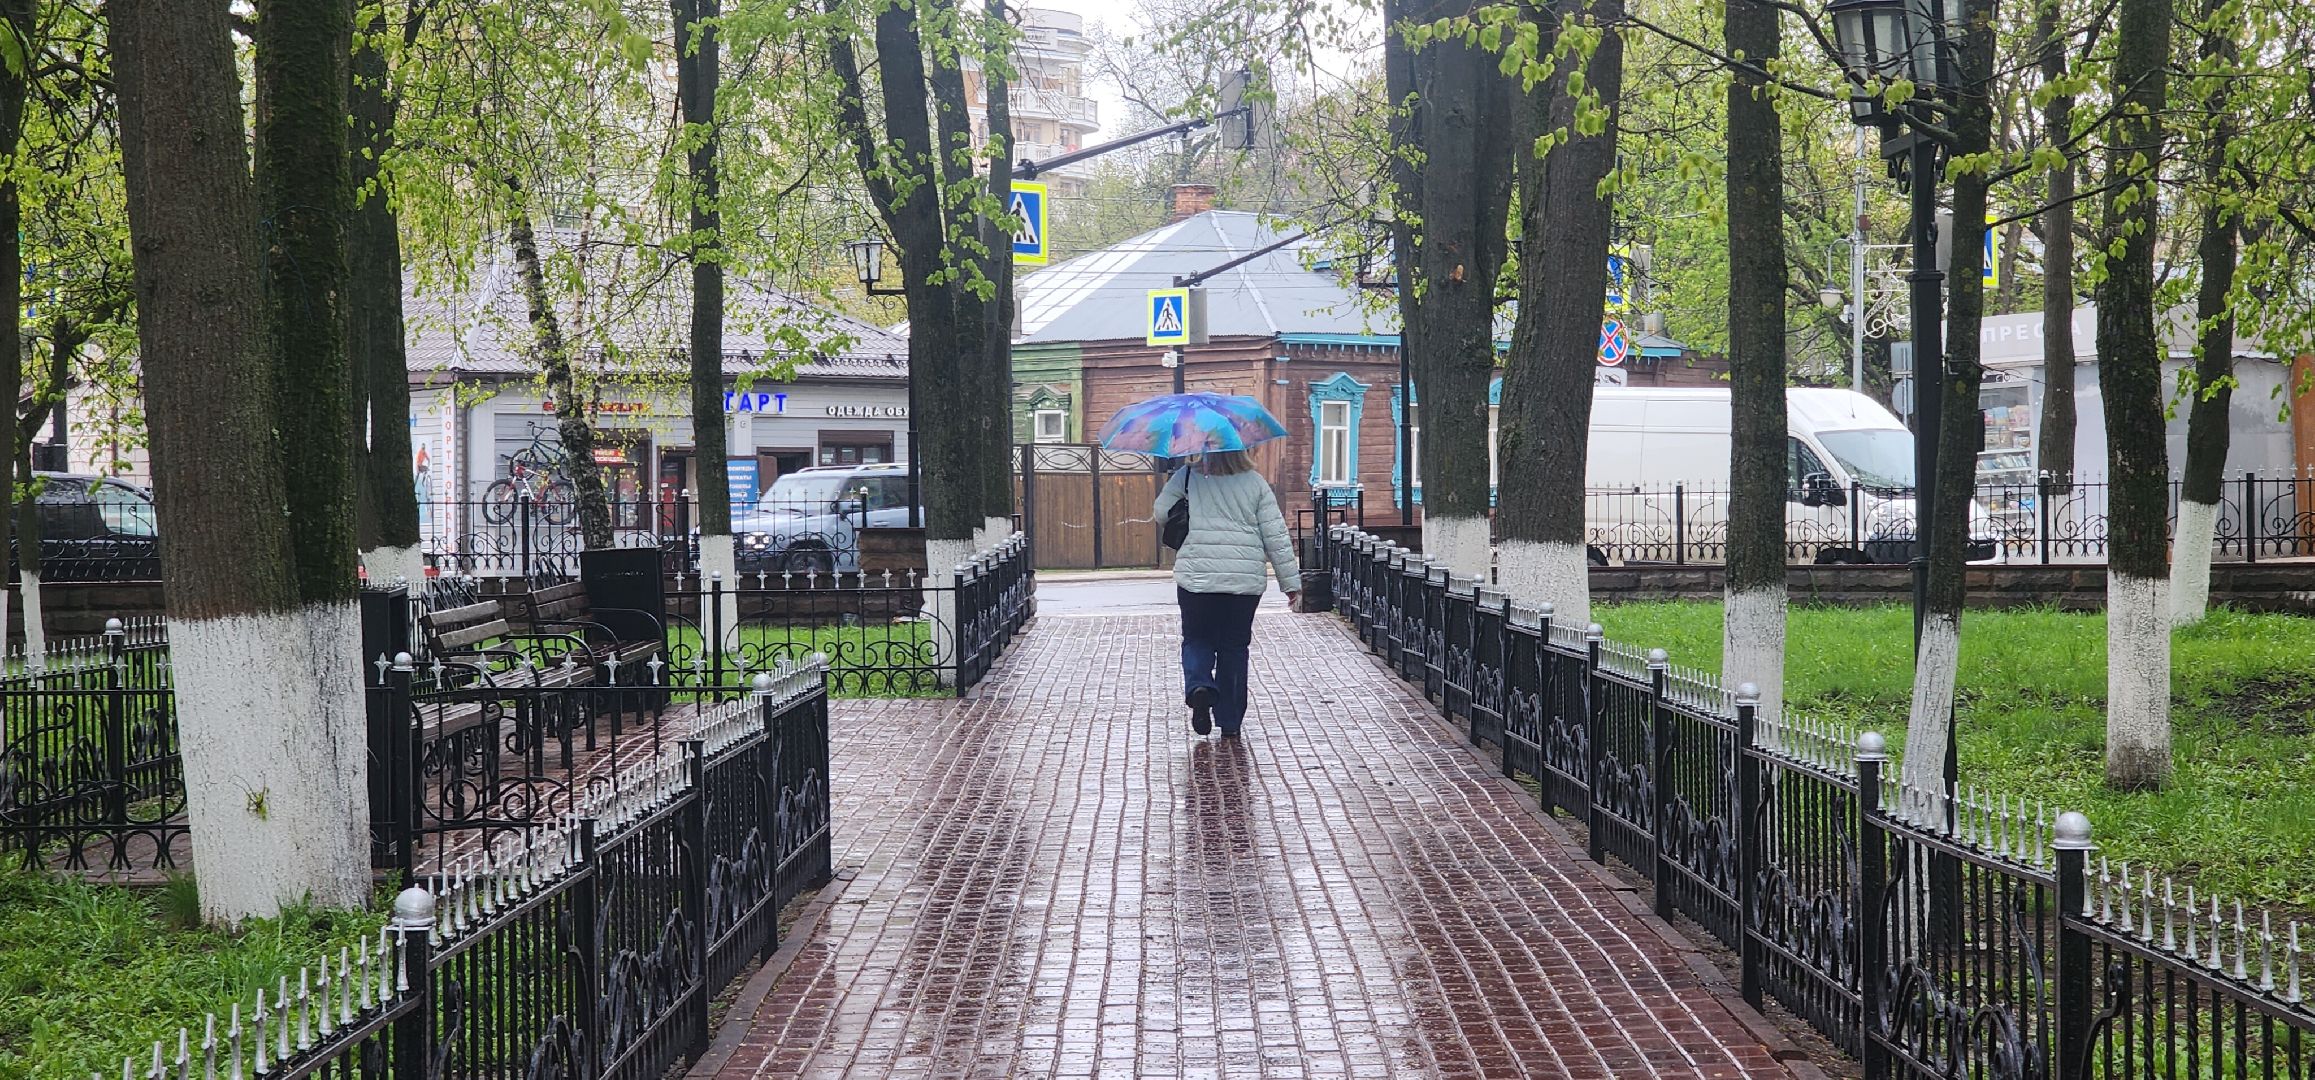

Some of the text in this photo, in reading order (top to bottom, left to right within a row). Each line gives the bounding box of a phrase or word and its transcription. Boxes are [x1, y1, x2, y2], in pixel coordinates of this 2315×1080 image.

[1982, 321, 2082, 344] ПРЕСА
[723, 392, 787, 412] ТАРТ
[827, 406, 909, 417] ОДЕЖДА ОБУ
